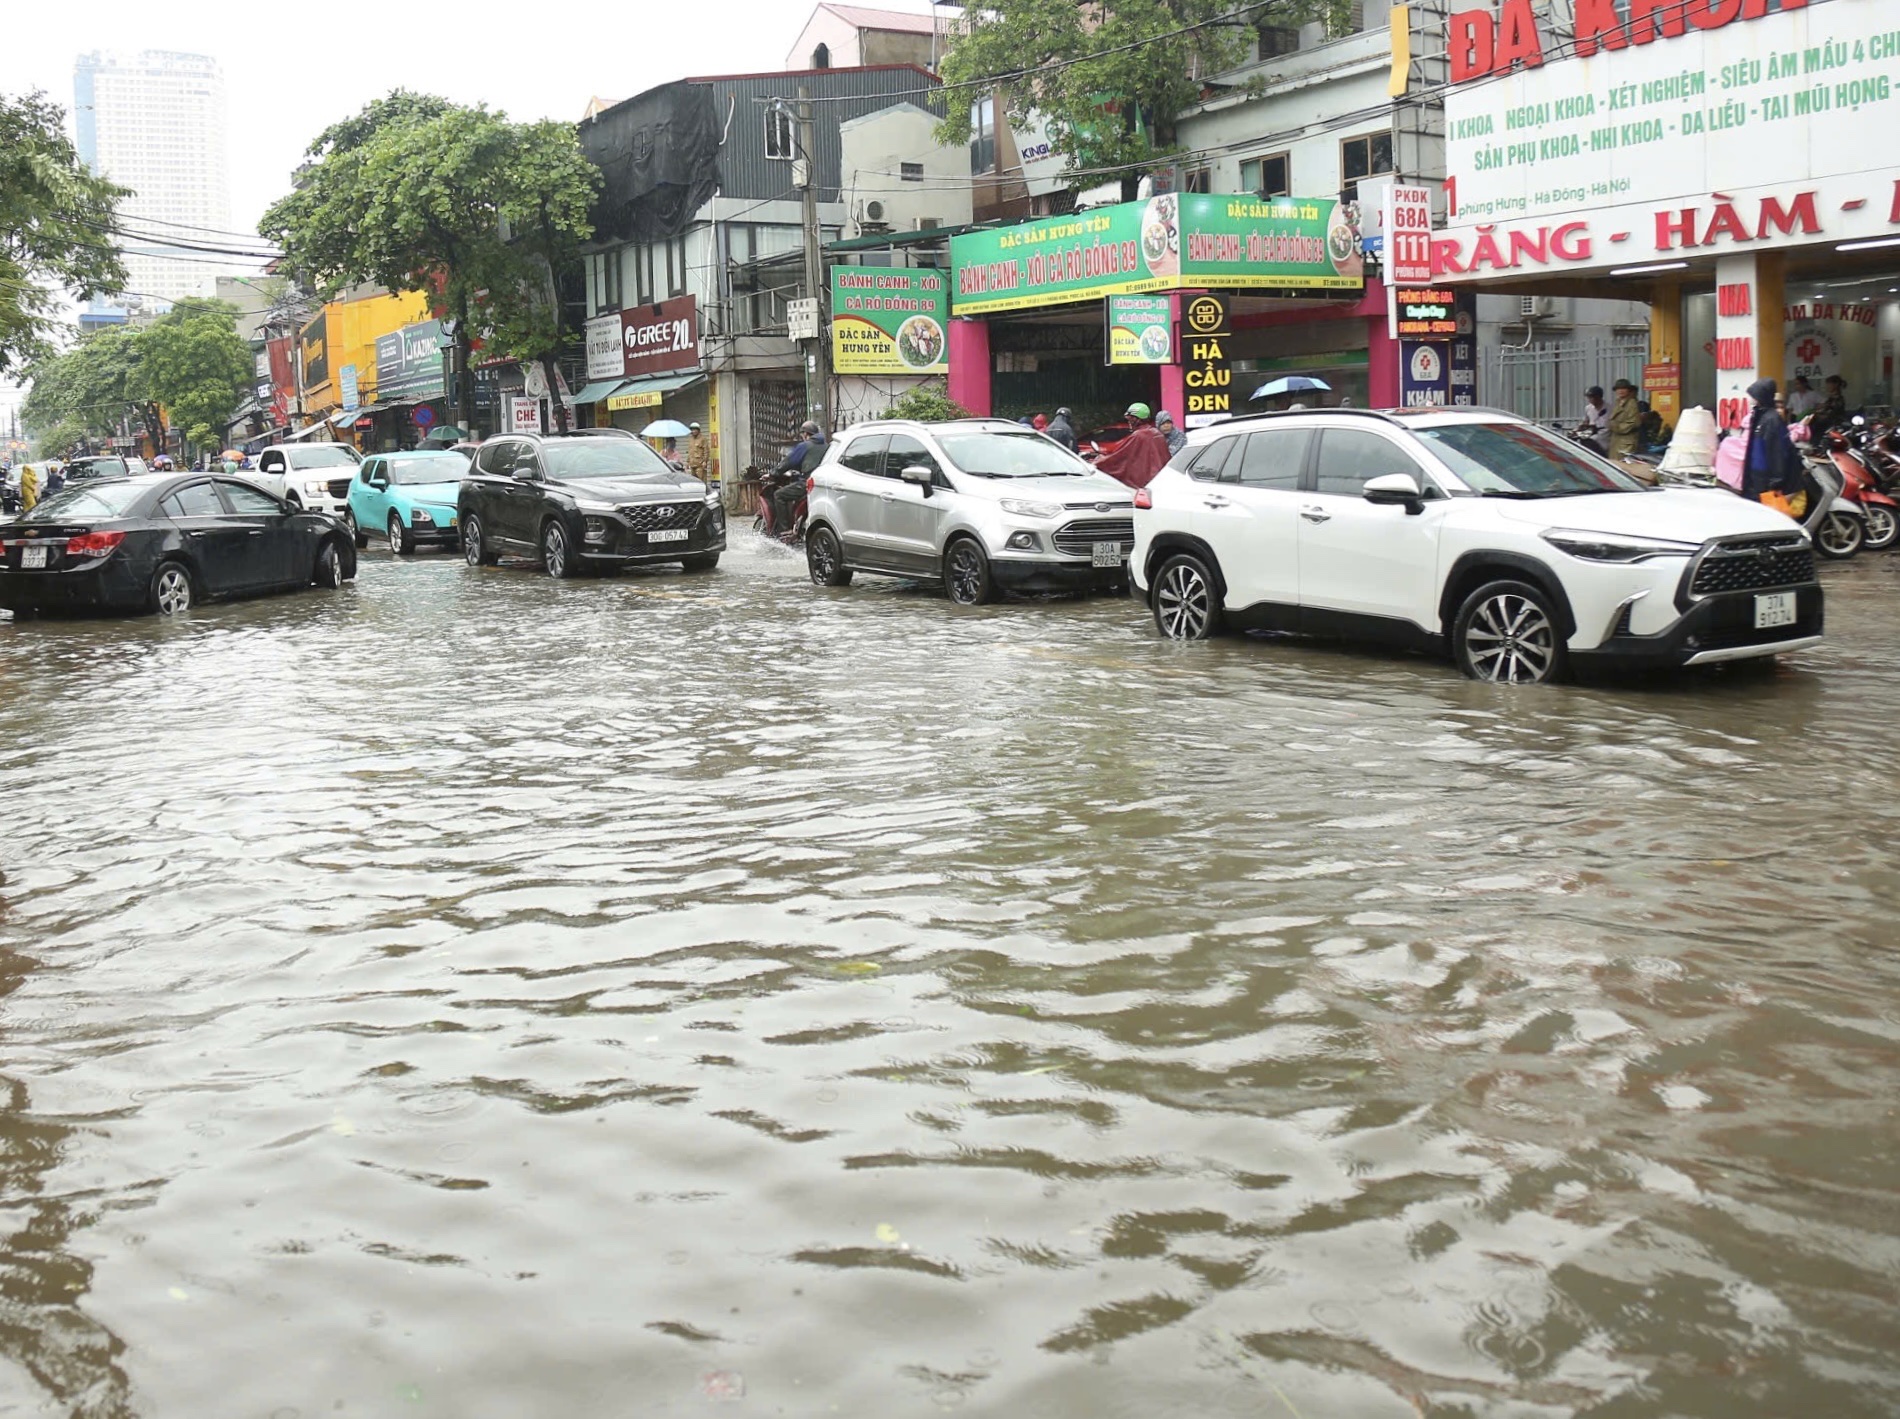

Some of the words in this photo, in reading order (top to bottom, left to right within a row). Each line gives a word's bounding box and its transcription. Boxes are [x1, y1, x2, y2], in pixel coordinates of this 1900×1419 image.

[1447, 0, 1544, 84] ĐA
[1458, 115, 1494, 140] KHOA
[1506, 102, 1550, 131] NGOẠI
[1555, 94, 1596, 121] KHOA
[1608, 81, 1638, 111] XÉT
[1642, 69, 1705, 106] NGHIỆM
[1721, 58, 1761, 89] SIÊU
[1768, 51, 1798, 80] ÂM
[1804, 36, 1848, 74] MẦU
[1852, 40, 1865, 63] 4
[1474, 143, 1503, 171] SẢN
[1507, 141, 1536, 167] PHỤ
[1540, 134, 1580, 161] KHOA
[1591, 127, 1617, 151] NHI
[1621, 118, 1664, 147] KHOA
[1682, 111, 1705, 136] DA
[1761, 94, 1788, 122] TAI
[1794, 83, 1830, 116] MŨI
[1836, 75, 1890, 111] HỌNG
[1395, 189, 1428, 203] PKĐK
[1395, 207, 1428, 228] 68A
[1431, 221, 1593, 275] RĂNG
[1654, 191, 1824, 251] HÀM
[1214, 234, 1240, 262] CANH
[1396, 235, 1428, 261] 111
[989, 258, 1019, 291] CANH
[1121, 240, 1137, 272] 89
[838, 271, 873, 289] BÁNH
[876, 274, 911, 290] CANH
[921, 274, 942, 292] XÔI
[846, 294, 863, 311] CÁ
[865, 295, 882, 311] RÔ
[884, 294, 919, 311] ĐỒNG
[921, 299, 936, 312] 89
[637, 321, 671, 346] GREE
[839, 327, 859, 343] ĐẶC
[861, 327, 880, 340] SẢN
[872, 341, 891, 354] YÊN
[1193, 338, 1223, 360] HÀ
[1186, 361, 1230, 387] CẦU
[1188, 394, 1229, 411] ĐEN
[1100, 543, 1115, 554] 30A
